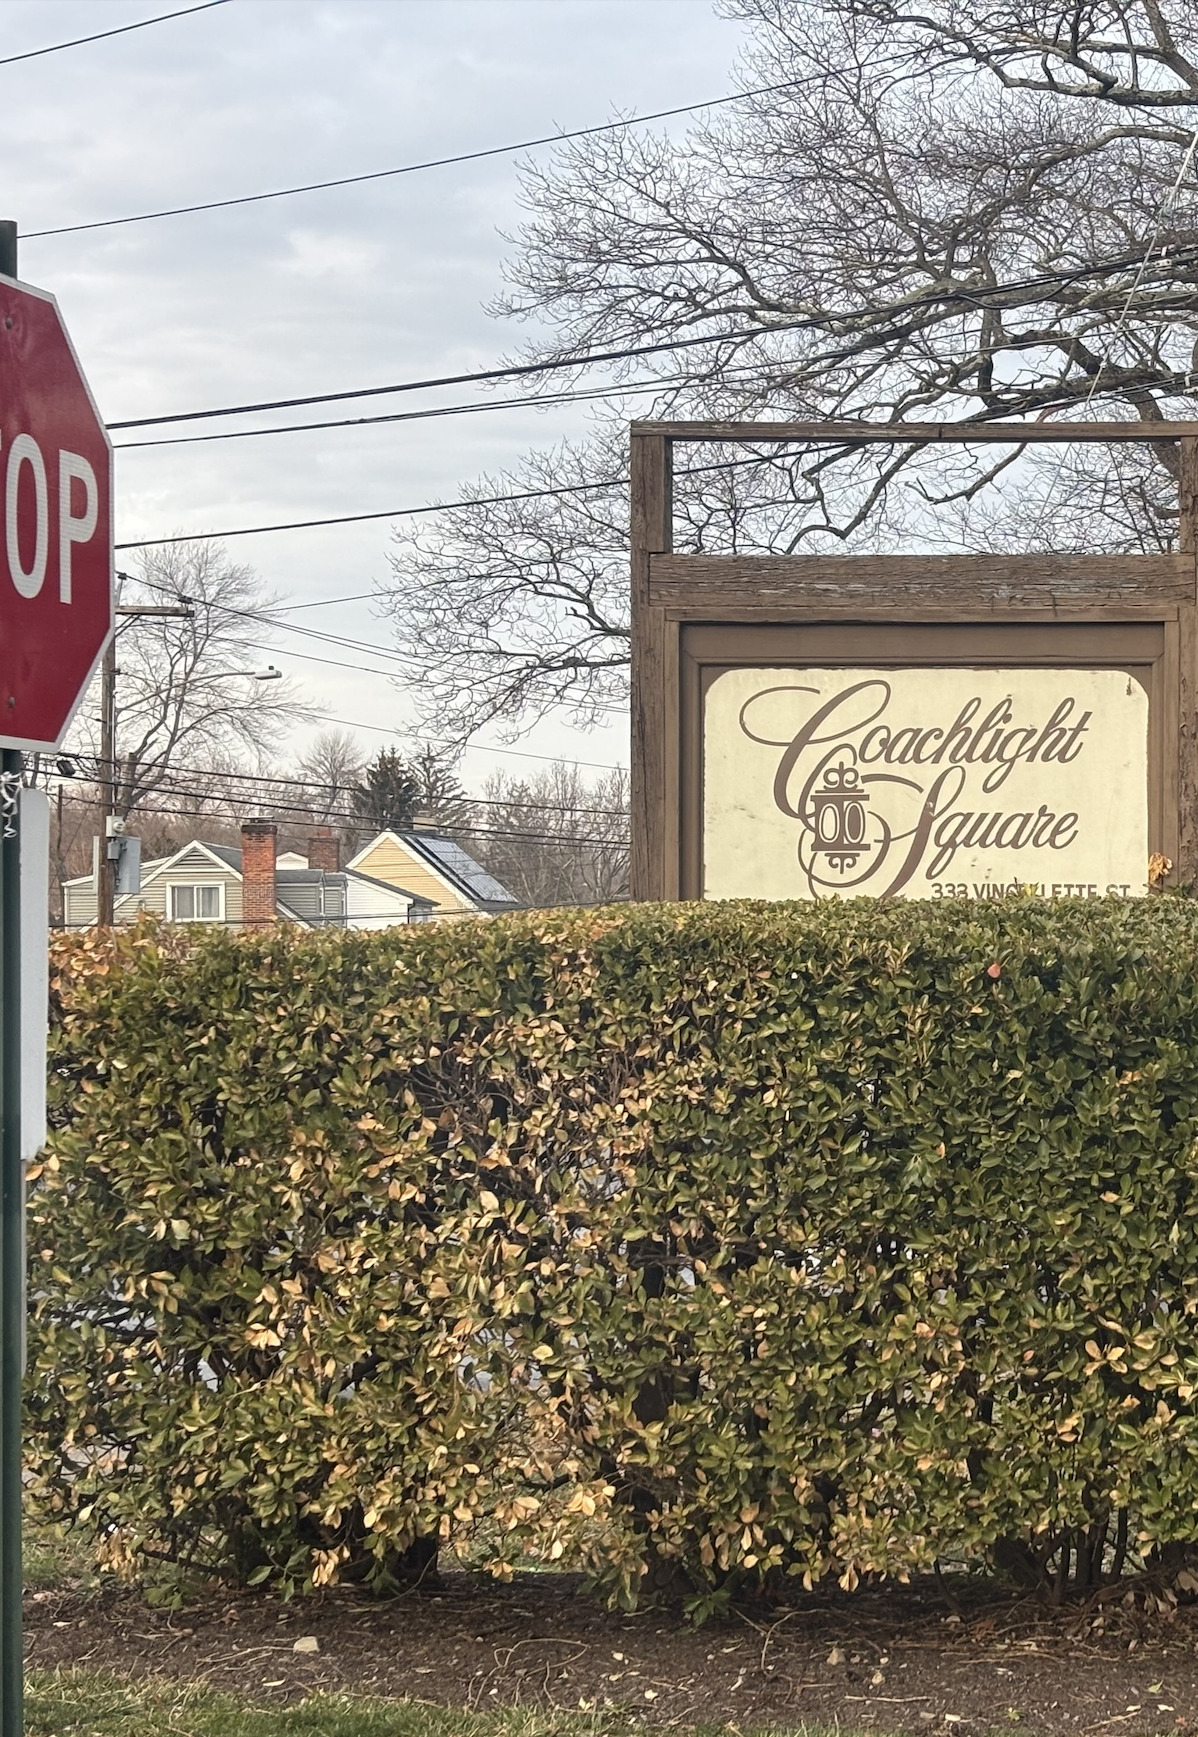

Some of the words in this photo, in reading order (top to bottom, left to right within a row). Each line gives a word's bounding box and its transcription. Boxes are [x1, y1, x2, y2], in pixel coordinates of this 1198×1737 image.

[0, 430, 99, 605] OP
[739, 679, 1093, 819] Coachlight
[862, 766, 1079, 899] Square
[931, 882, 968, 900] 333
[973, 883, 1098, 899] VINCLETTE
